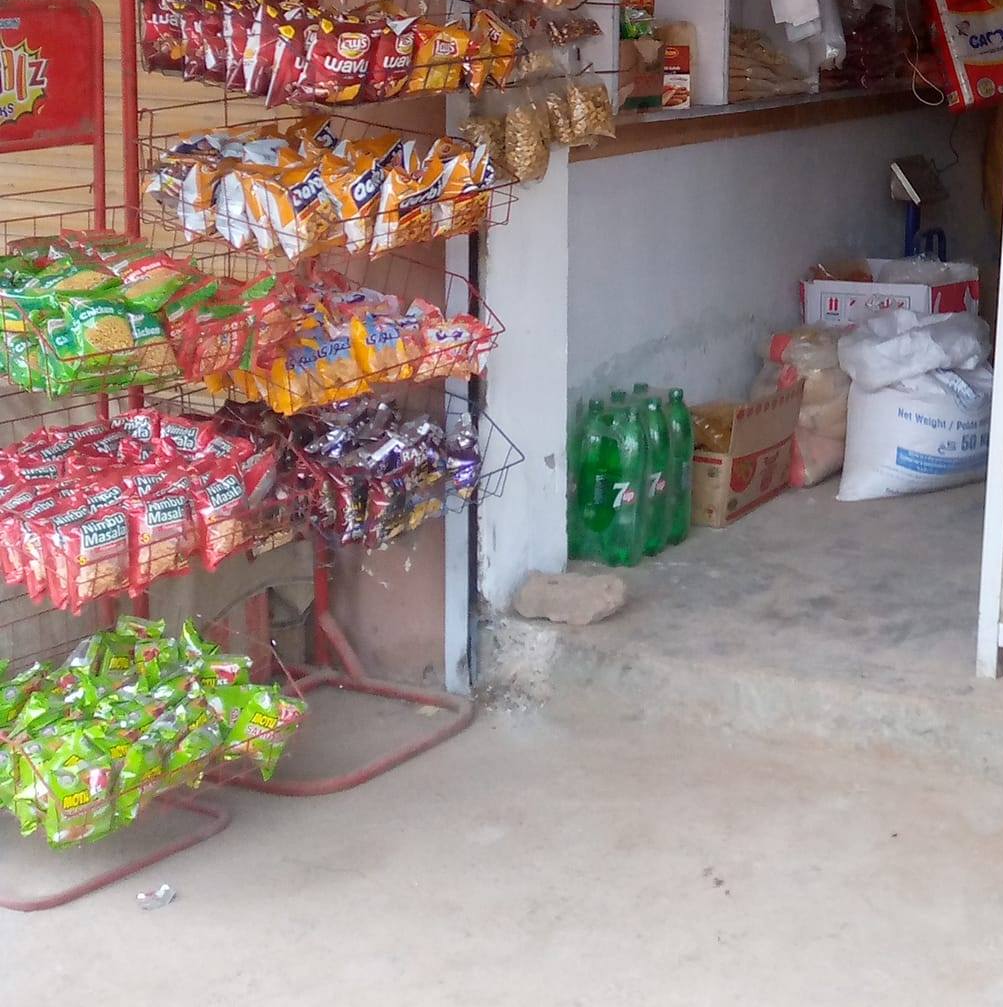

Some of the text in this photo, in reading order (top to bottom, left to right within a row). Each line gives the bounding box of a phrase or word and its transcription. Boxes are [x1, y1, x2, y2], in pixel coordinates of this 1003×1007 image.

[898, 407, 912, 420] Net
[915, 413, 946, 429] Weight
[83, 513, 124, 533] Nimbu
[84, 524, 127, 548] Masala
